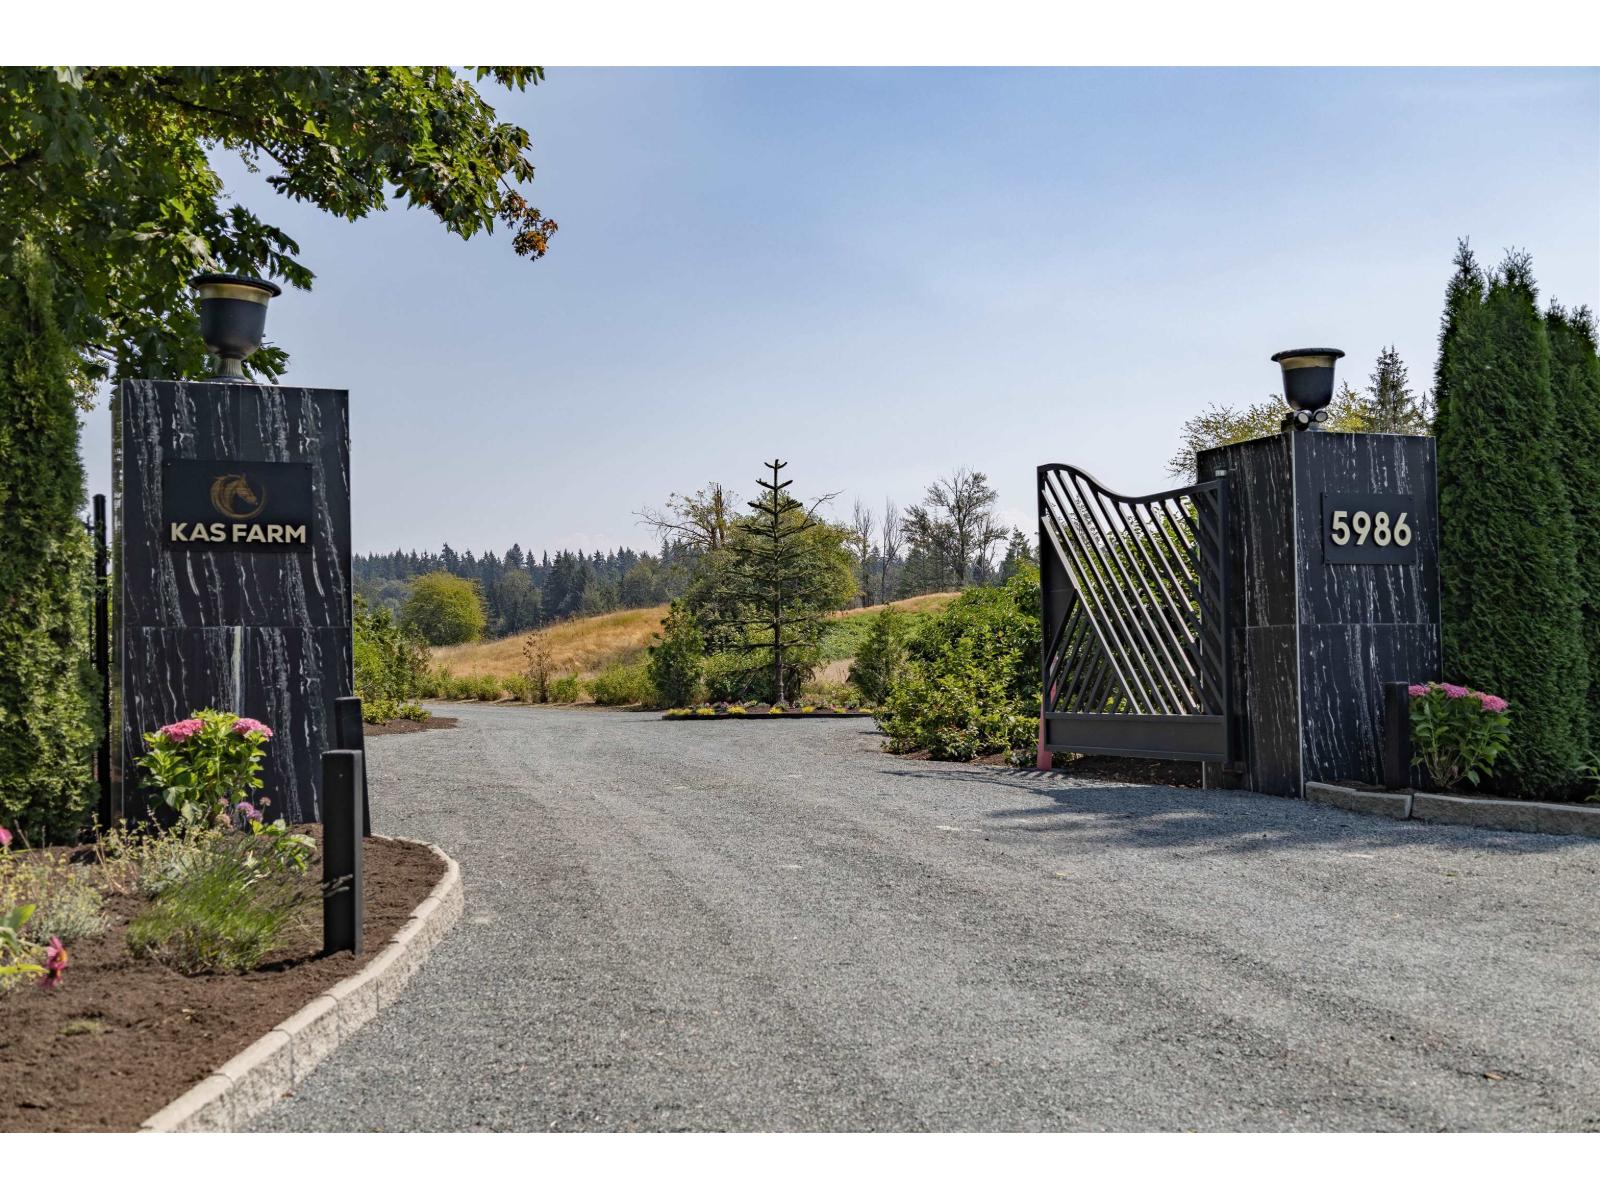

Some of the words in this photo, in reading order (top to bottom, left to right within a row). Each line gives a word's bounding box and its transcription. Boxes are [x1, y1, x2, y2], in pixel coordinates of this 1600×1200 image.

[171, 522, 226, 543] KAS
[232, 523, 307, 544] FARM
[1331, 510, 1413, 547] 5986
